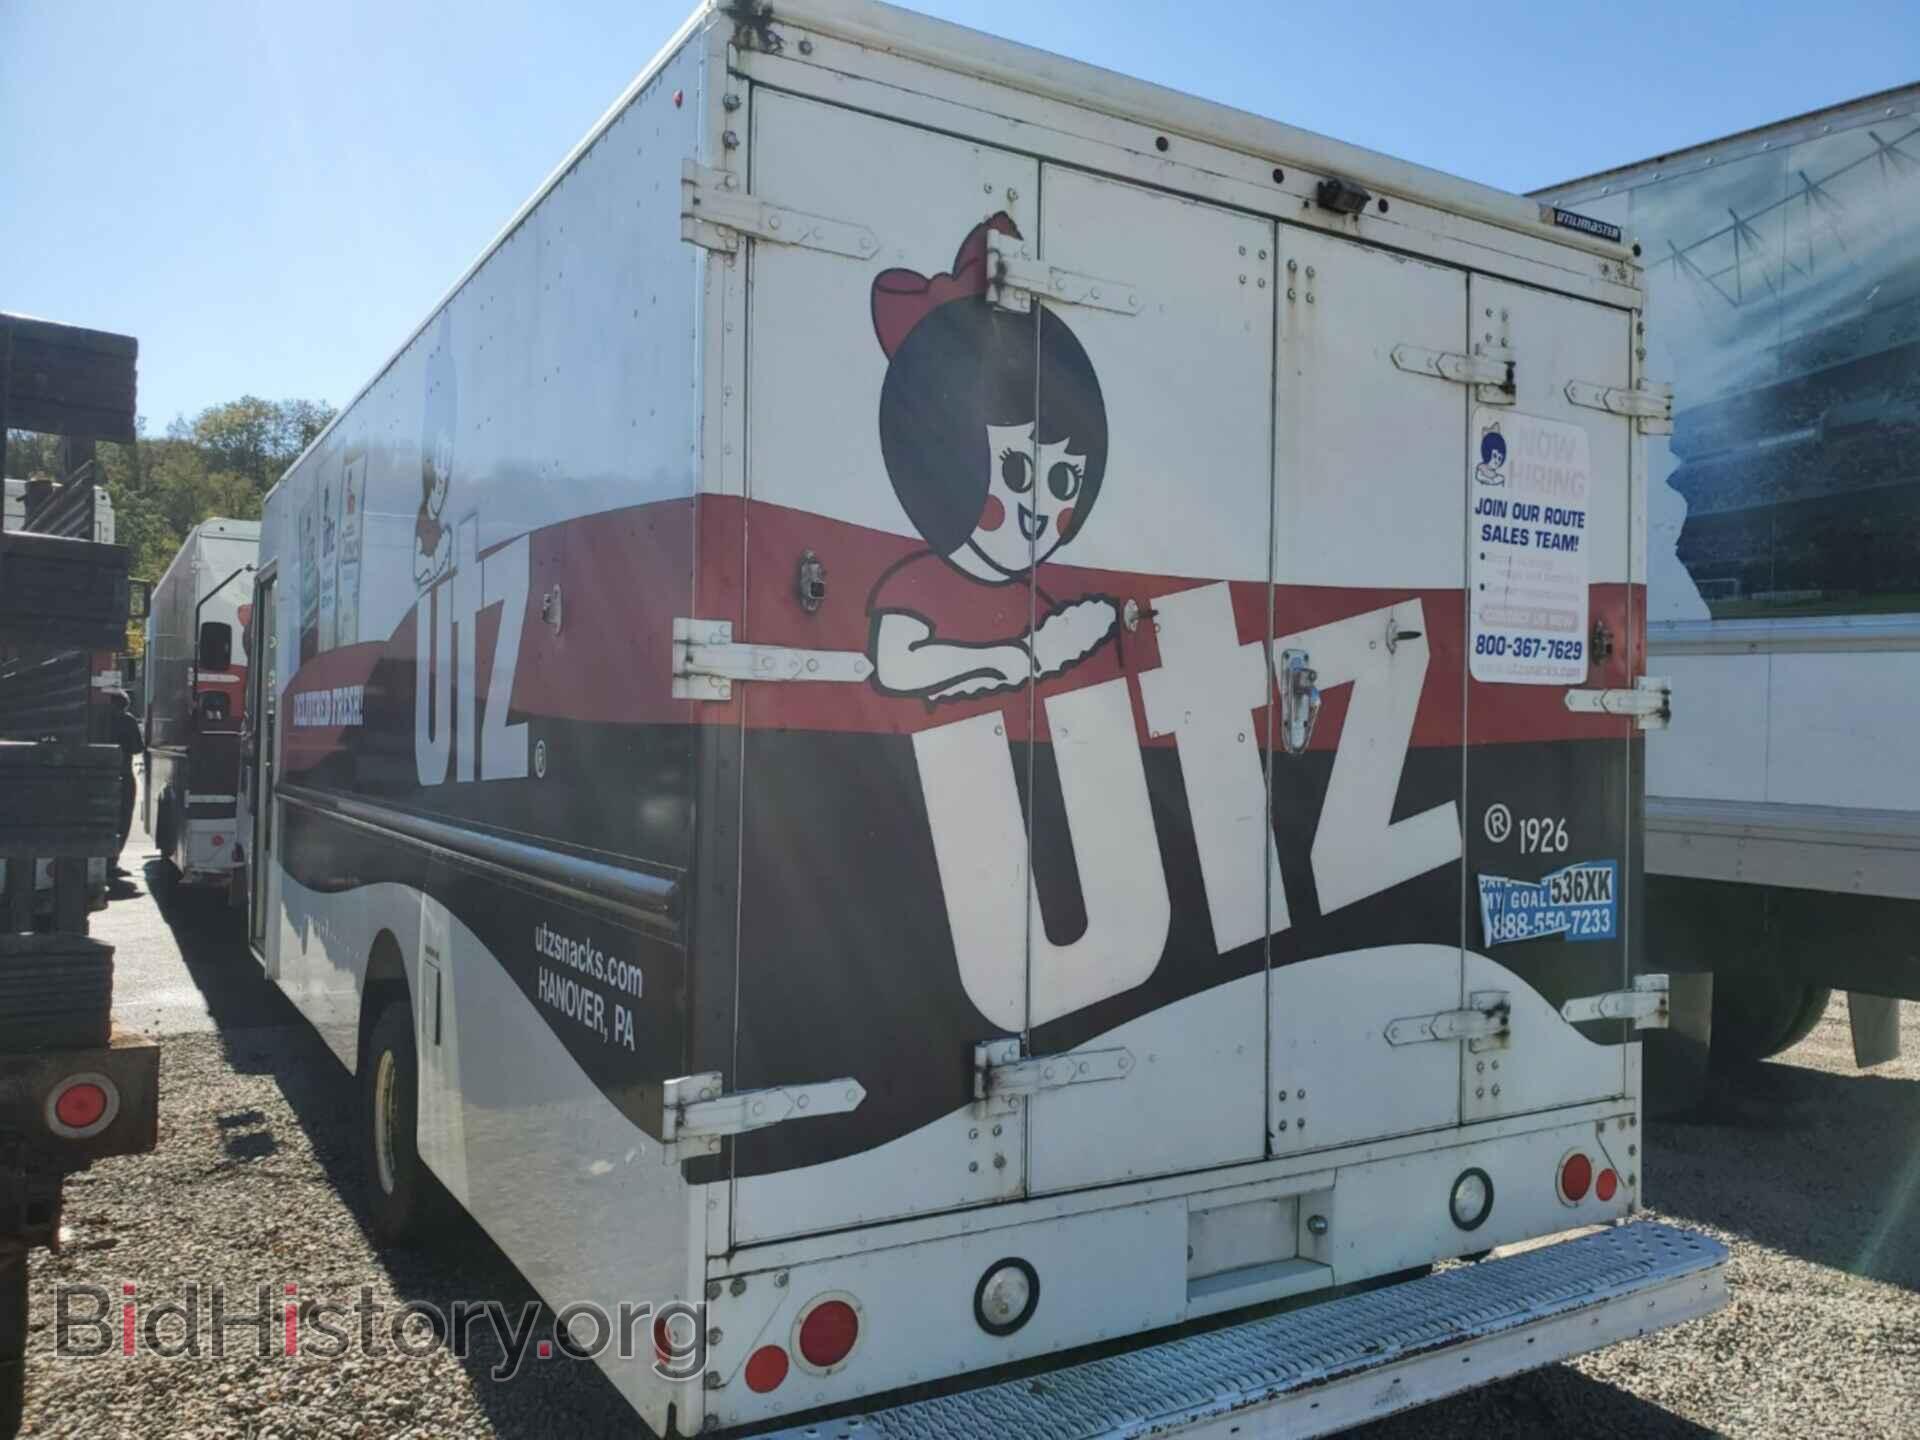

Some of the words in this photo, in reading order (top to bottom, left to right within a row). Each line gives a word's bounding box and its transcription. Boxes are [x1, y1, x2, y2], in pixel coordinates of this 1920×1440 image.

[1517, 427, 1577, 462] NOW
[1508, 460, 1585, 496] HIRING
[1475, 498, 1508, 518] JOIN
[1512, 501, 1540, 523] OUR
[1544, 507, 1586, 529] ROUTE
[1481, 524, 1530, 547] SALES
[1535, 530, 1580, 552] TEAM!
[1475, 634, 1583, 660] 800-367-7629
[1519, 817, 1569, 854] 1926
[1511, 890, 1548, 909] GOAL
[1551, 870, 1611, 904] 536XK
[535, 921, 642, 998] utzsnacks.com
[538, 966, 608, 1043] HANOVER,
[615, 1004, 635, 1052] PA
